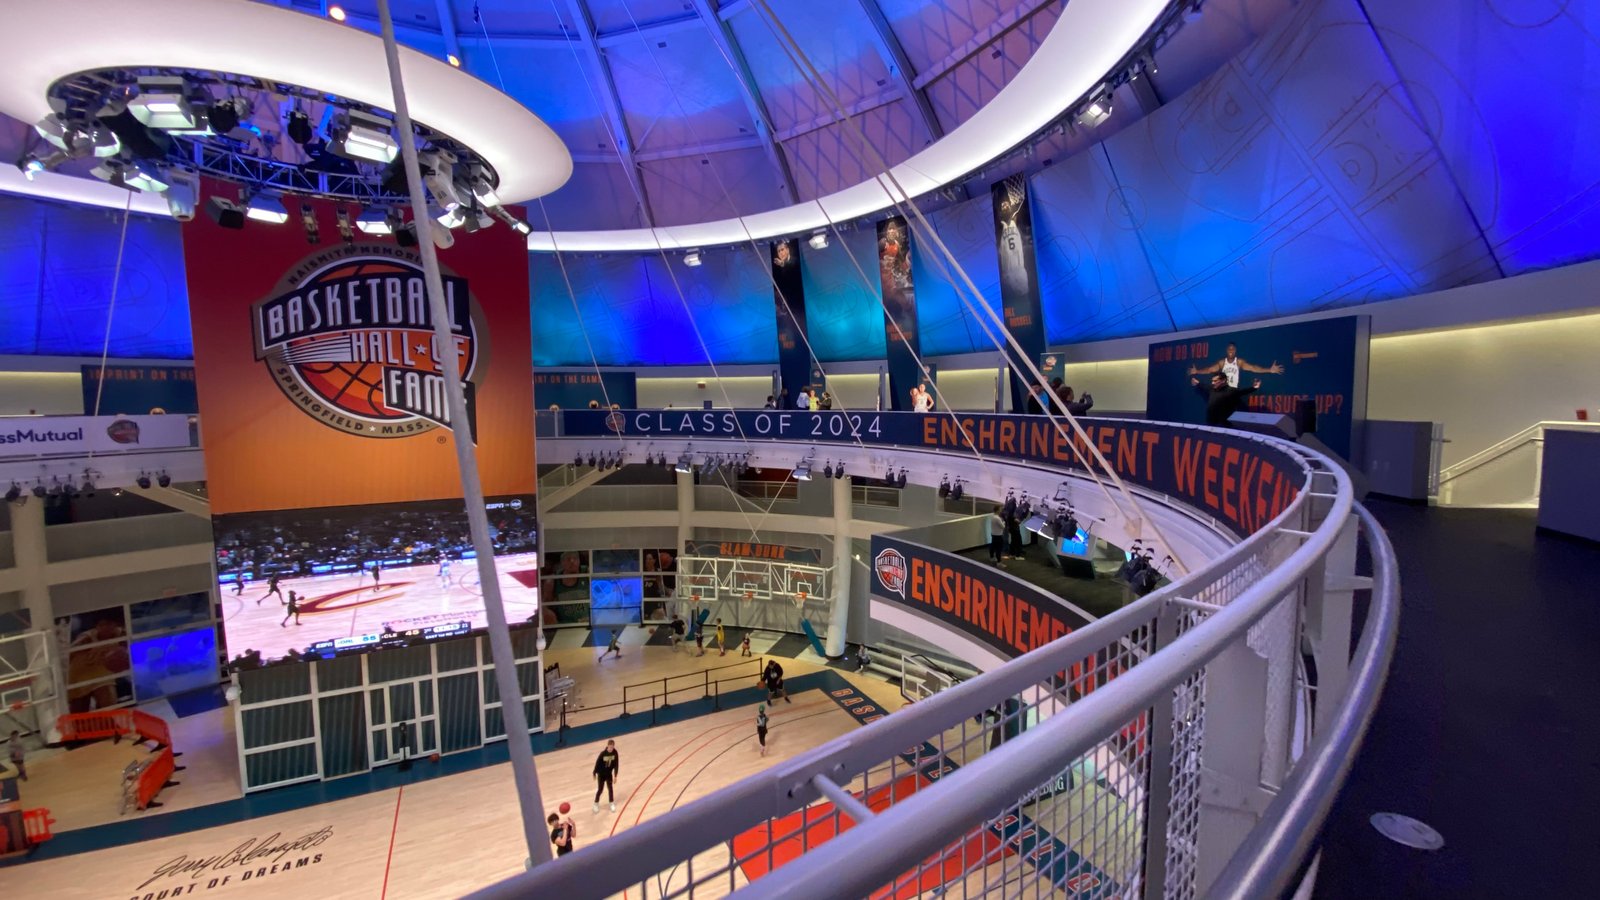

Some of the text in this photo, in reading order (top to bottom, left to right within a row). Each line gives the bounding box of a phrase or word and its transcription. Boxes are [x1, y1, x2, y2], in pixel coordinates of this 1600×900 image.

[360, 245, 424, 266] MEMORI
[267, 277, 463, 340] BASKETBAL
[351, 331, 416, 367] HALL
[1153, 342, 1209, 363] HOW DO YOU
[277, 367, 364, 431] SPRINGFIELD
[389, 369, 467, 423] FAM
[1248, 394, 1309, 414] MEASUR
[635, 412, 736, 433] CLASS
[755, 414, 792, 434] OF
[811, 414, 882, 438] 2024
[923, 417, 1299, 535] ENSHRINEMENT WEEKEN
[755, 544, 785, 559] DUNK
[207, 875, 231, 889] OF
[241, 853, 324, 881] DREAMS
